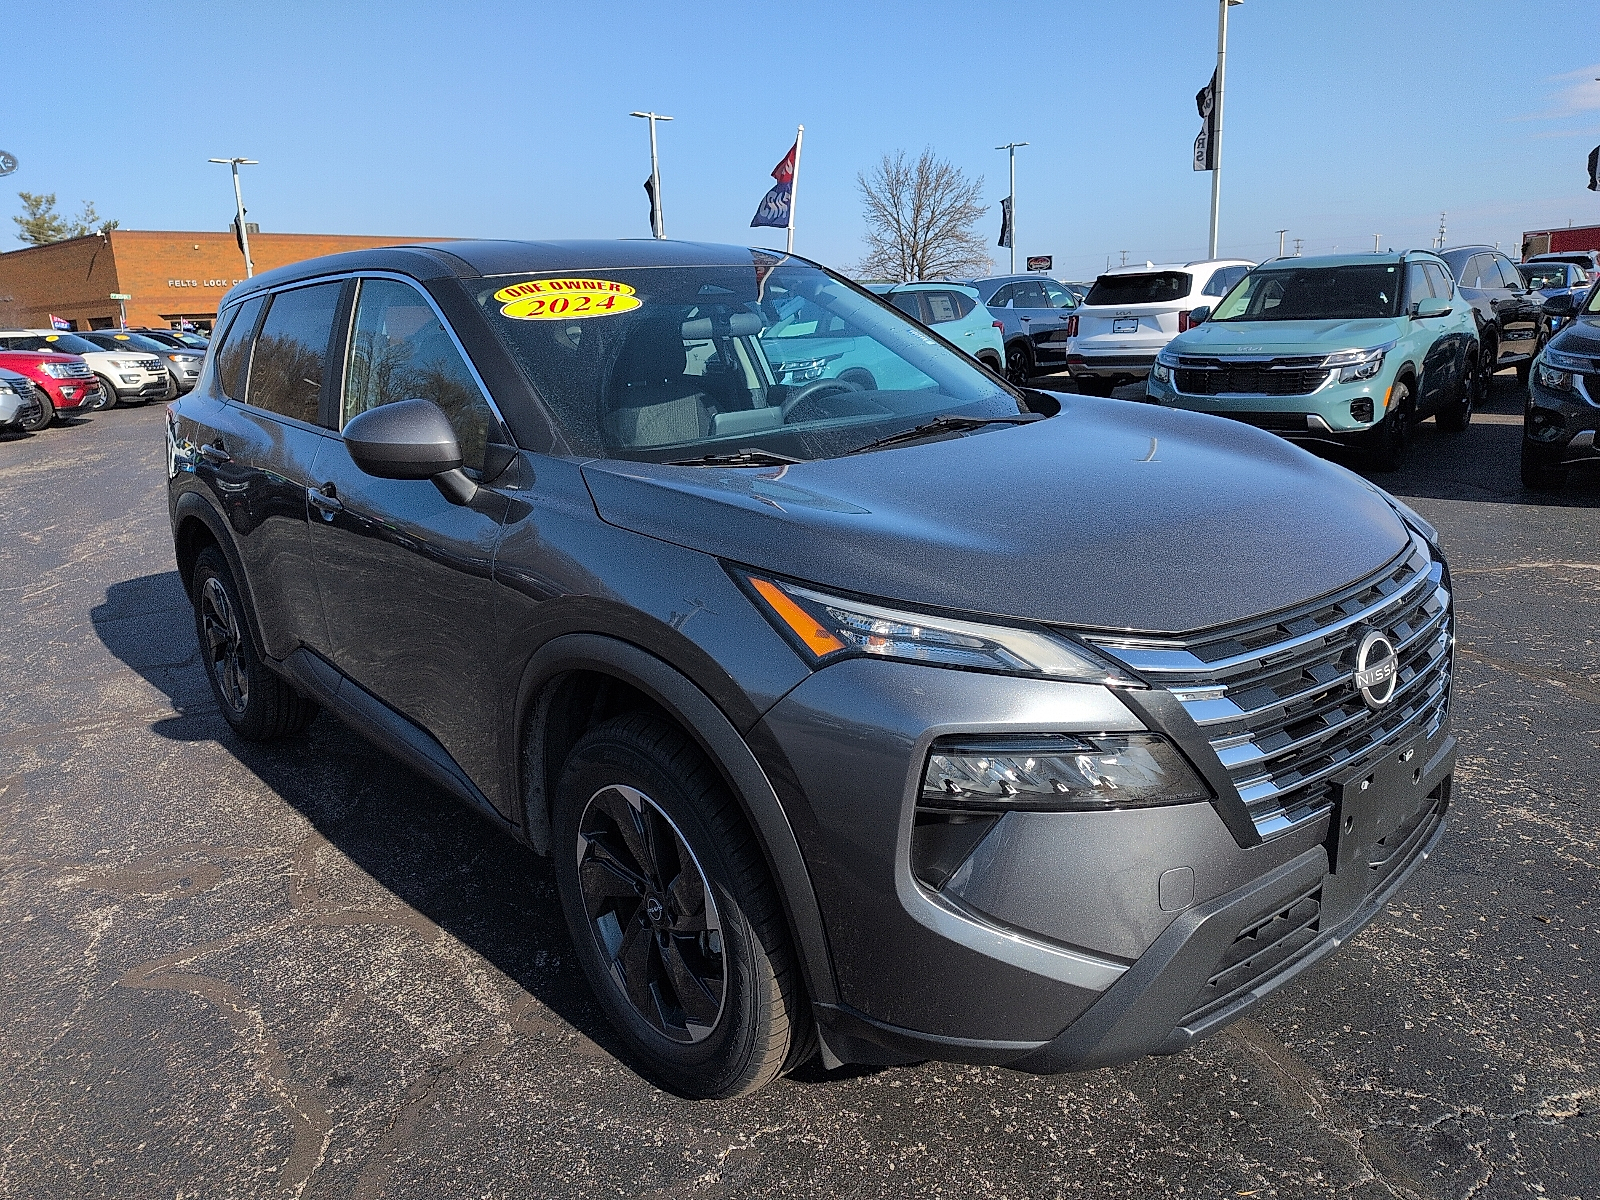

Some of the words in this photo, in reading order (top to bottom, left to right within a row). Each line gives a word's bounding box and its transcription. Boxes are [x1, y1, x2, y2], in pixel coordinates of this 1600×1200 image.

[168, 279, 198, 288] FELTS
[203, 279, 228, 288] LOCK
[504, 283, 546, 297] ONE
[549, 281, 621, 292] OWNER
[526, 295, 616, 317] 2024
[1357, 660, 1396, 687] NISSA
